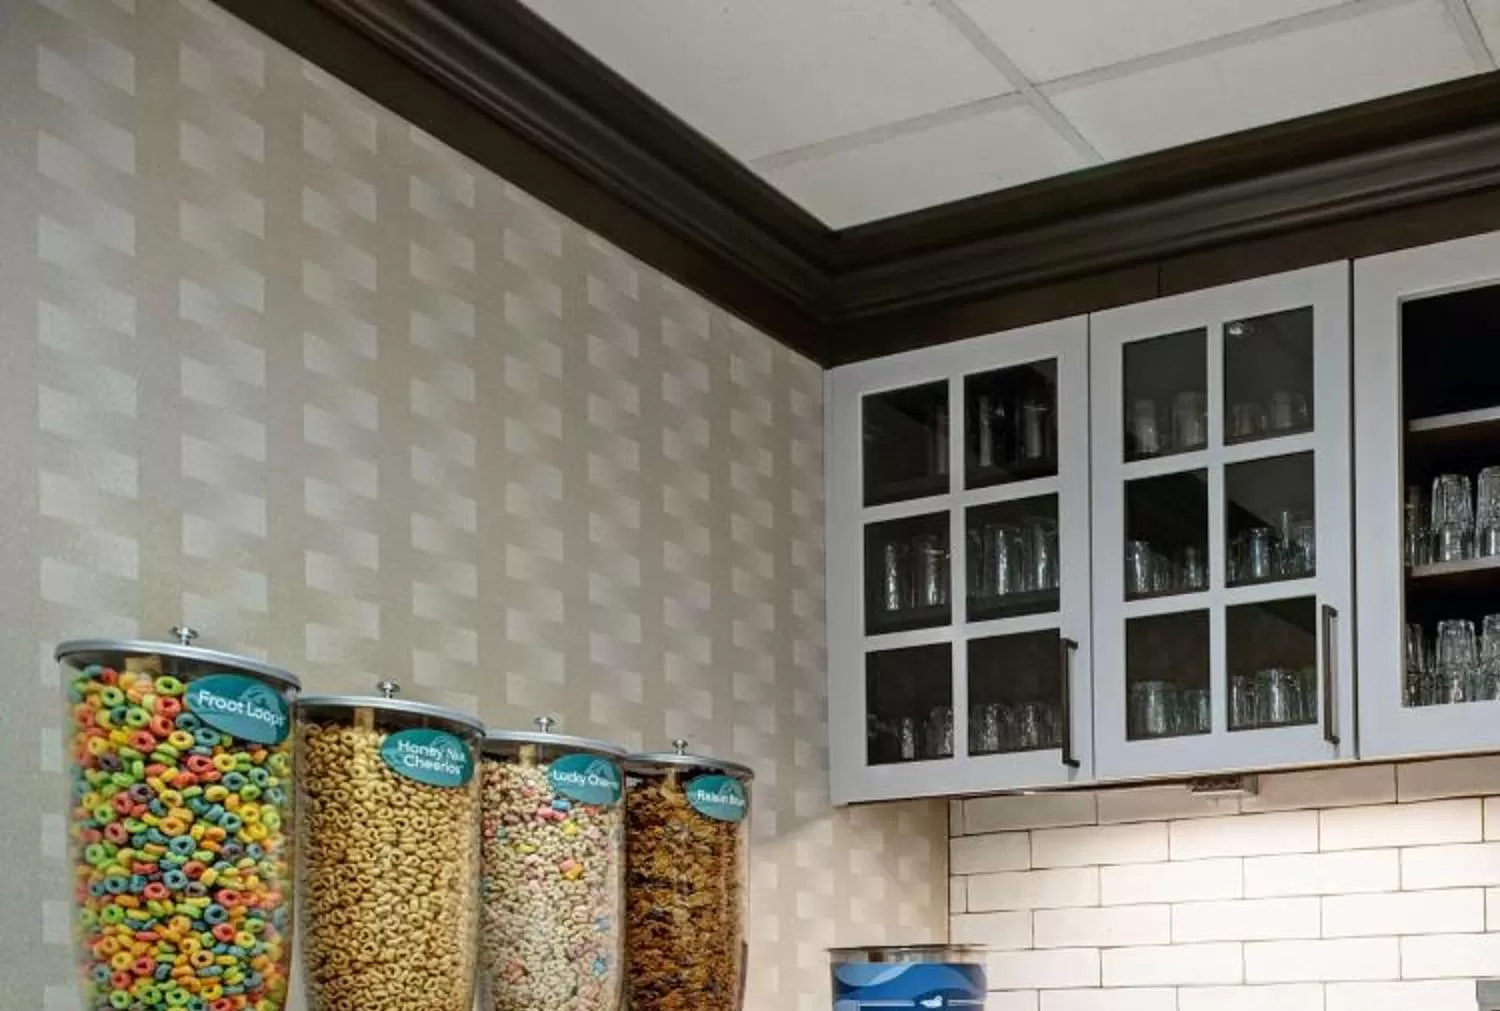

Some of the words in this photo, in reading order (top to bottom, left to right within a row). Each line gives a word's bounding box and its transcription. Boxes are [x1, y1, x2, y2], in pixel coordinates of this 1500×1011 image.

[199, 690, 244, 713] Froot
[397, 740, 443, 761] Honey
[553, 768, 586, 787] Lucky
